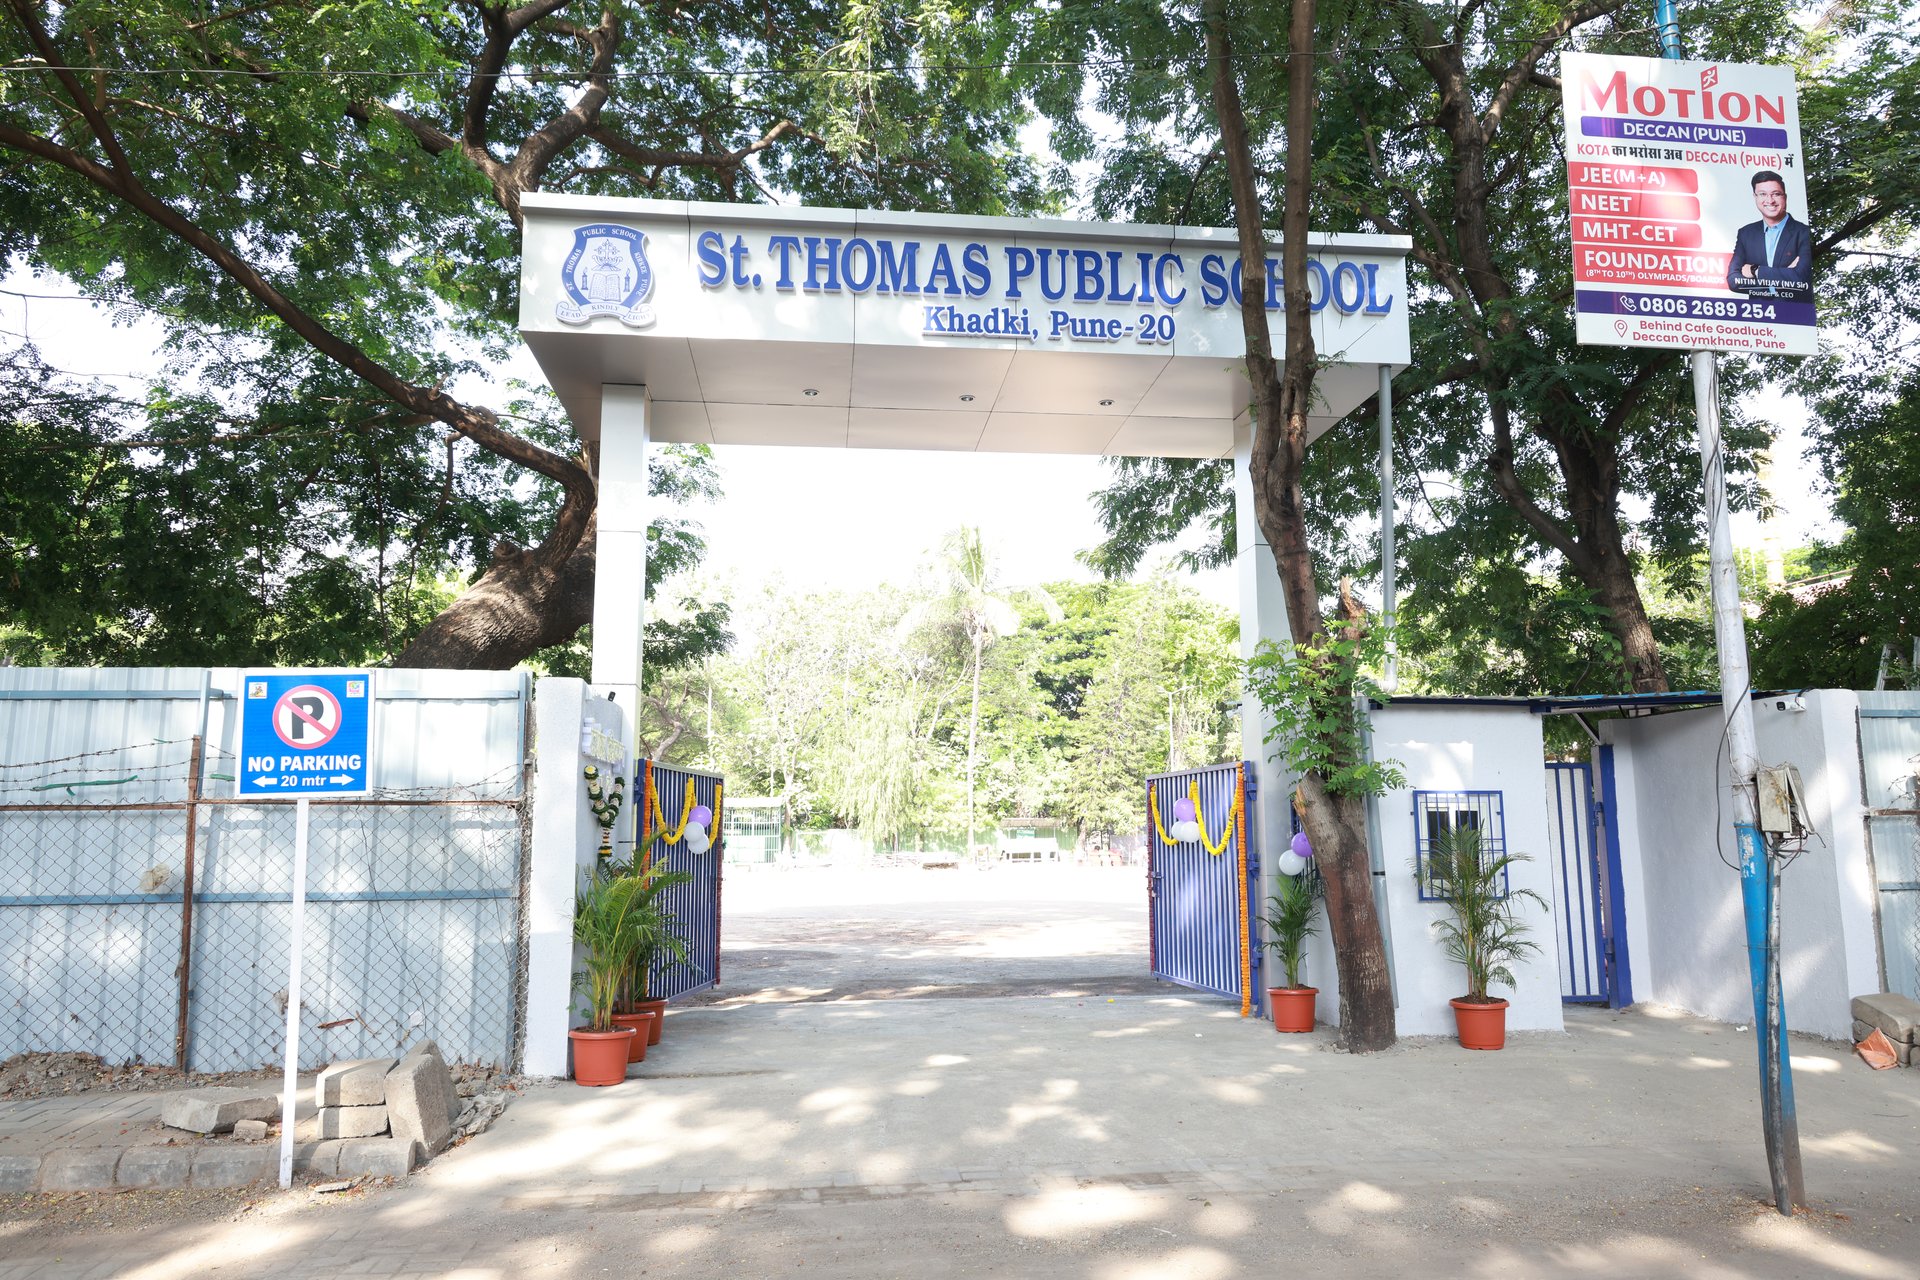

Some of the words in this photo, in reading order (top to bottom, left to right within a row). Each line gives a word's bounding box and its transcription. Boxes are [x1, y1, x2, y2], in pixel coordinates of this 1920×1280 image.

[1580, 66, 1786, 125] MOTION
[1623, 122, 1689, 140] DECCAN
[1693, 127, 1746, 145] (PUNE)
[1577, 143, 1610, 156] KOTA
[1611, 145, 1627, 157] का
[1629, 144, 1661, 160] भरोसा
[1664, 148, 1683, 161] अब
[1685, 150, 1737, 165] DECCAN
[1740, 154, 1782, 170] (PUNE)
[1784, 153, 1794, 168] में
[1581, 194, 1632, 212] NEET
[581, 227, 607, 238] PUBLIC
[611, 228, 637, 240] SCHOOL
[1582, 221, 1678, 242] MHT-CET
[566, 248, 582, 273] THOMAS
[1584, 250, 1725, 274] FOUNDATION
[1004, 247, 1187, 308] PUBLIC
[1602, 270, 1614, 278] TO
[1734, 277, 1756, 285] NITIN
[1781, 280, 1795, 288] (NV
[1796, 281, 1809, 290] Sir)
[635, 278, 648, 297] PUNE
[1748, 289, 1774, 298] Founder
[560, 310, 581, 318] LEAD
[591, 304, 619, 312] KINDLY
[1639, 297, 1688, 315] 0806
[1691, 300, 1738, 318] 2689
[1741, 303, 1776, 320] 254
[922, 304, 1038, 342] Khadki,
[1639, 320, 1683, 332] Behind
[1684, 322, 1713, 334] Cafe
[1715, 324, 1777, 338] Goodluck,
[1632, 331, 1679, 343] Deccan
[1681, 333, 1753, 348] Gymkhana,
[1755, 338, 1786, 350] Pune
[248, 756, 275, 772] NO
[280, 754, 361, 772] PARKING
[280, 775, 298, 787] 20
[302, 774, 326, 786] mtr
